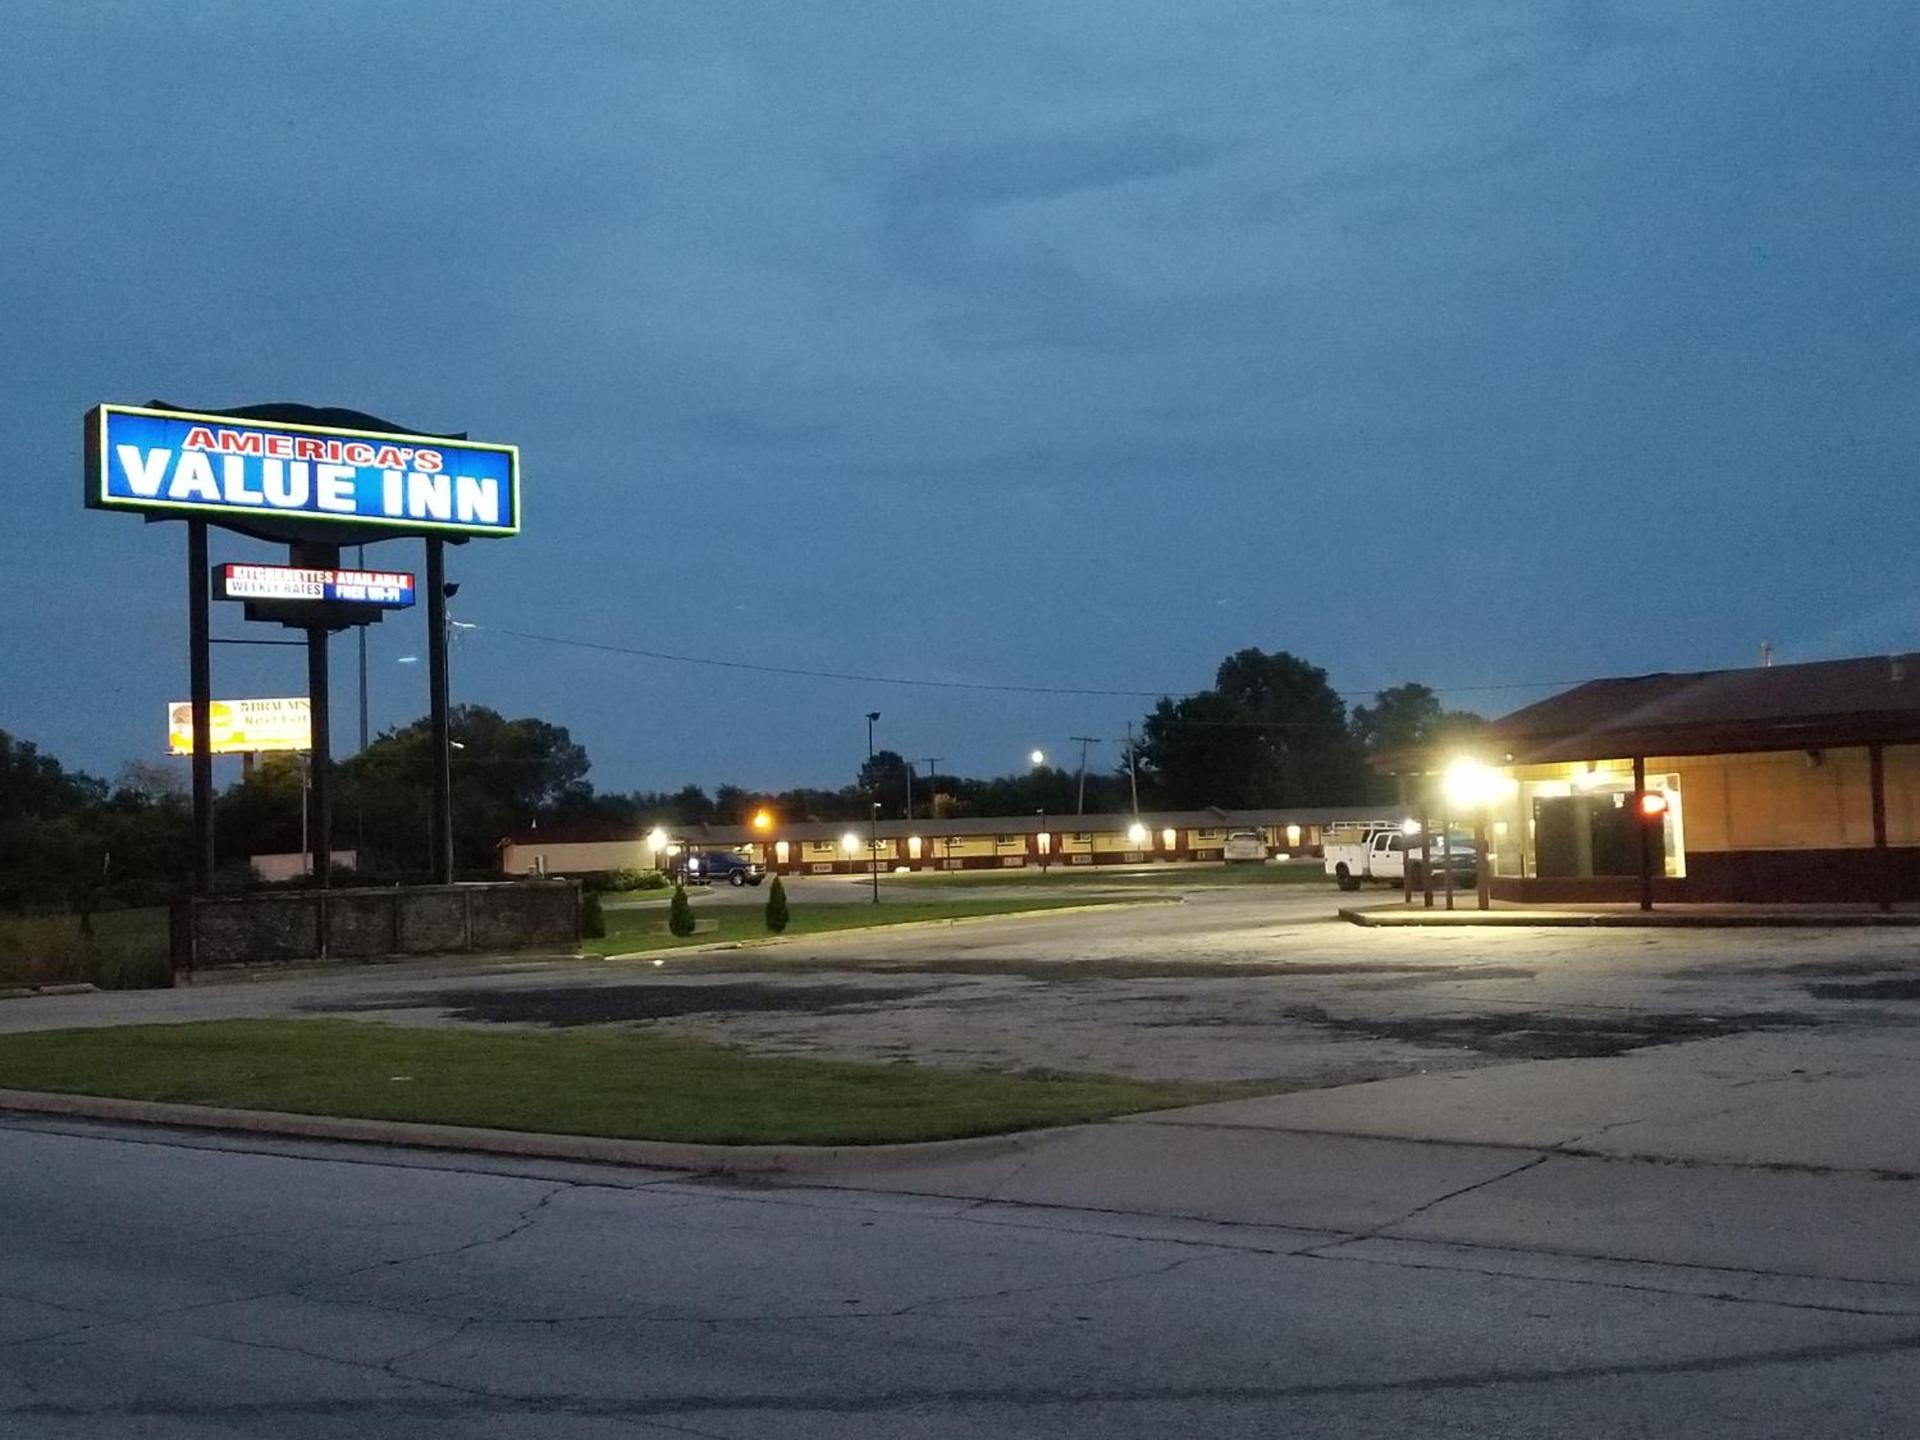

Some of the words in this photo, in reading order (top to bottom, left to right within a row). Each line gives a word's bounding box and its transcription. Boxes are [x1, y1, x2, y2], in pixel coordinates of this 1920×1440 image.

[182, 427, 443, 473] AMERICA'S
[116, 444, 357, 512] VALUE
[382, 470, 499, 523] INN
[232, 581, 279, 593] WEEKLY
[284, 583, 321, 595] RATES
